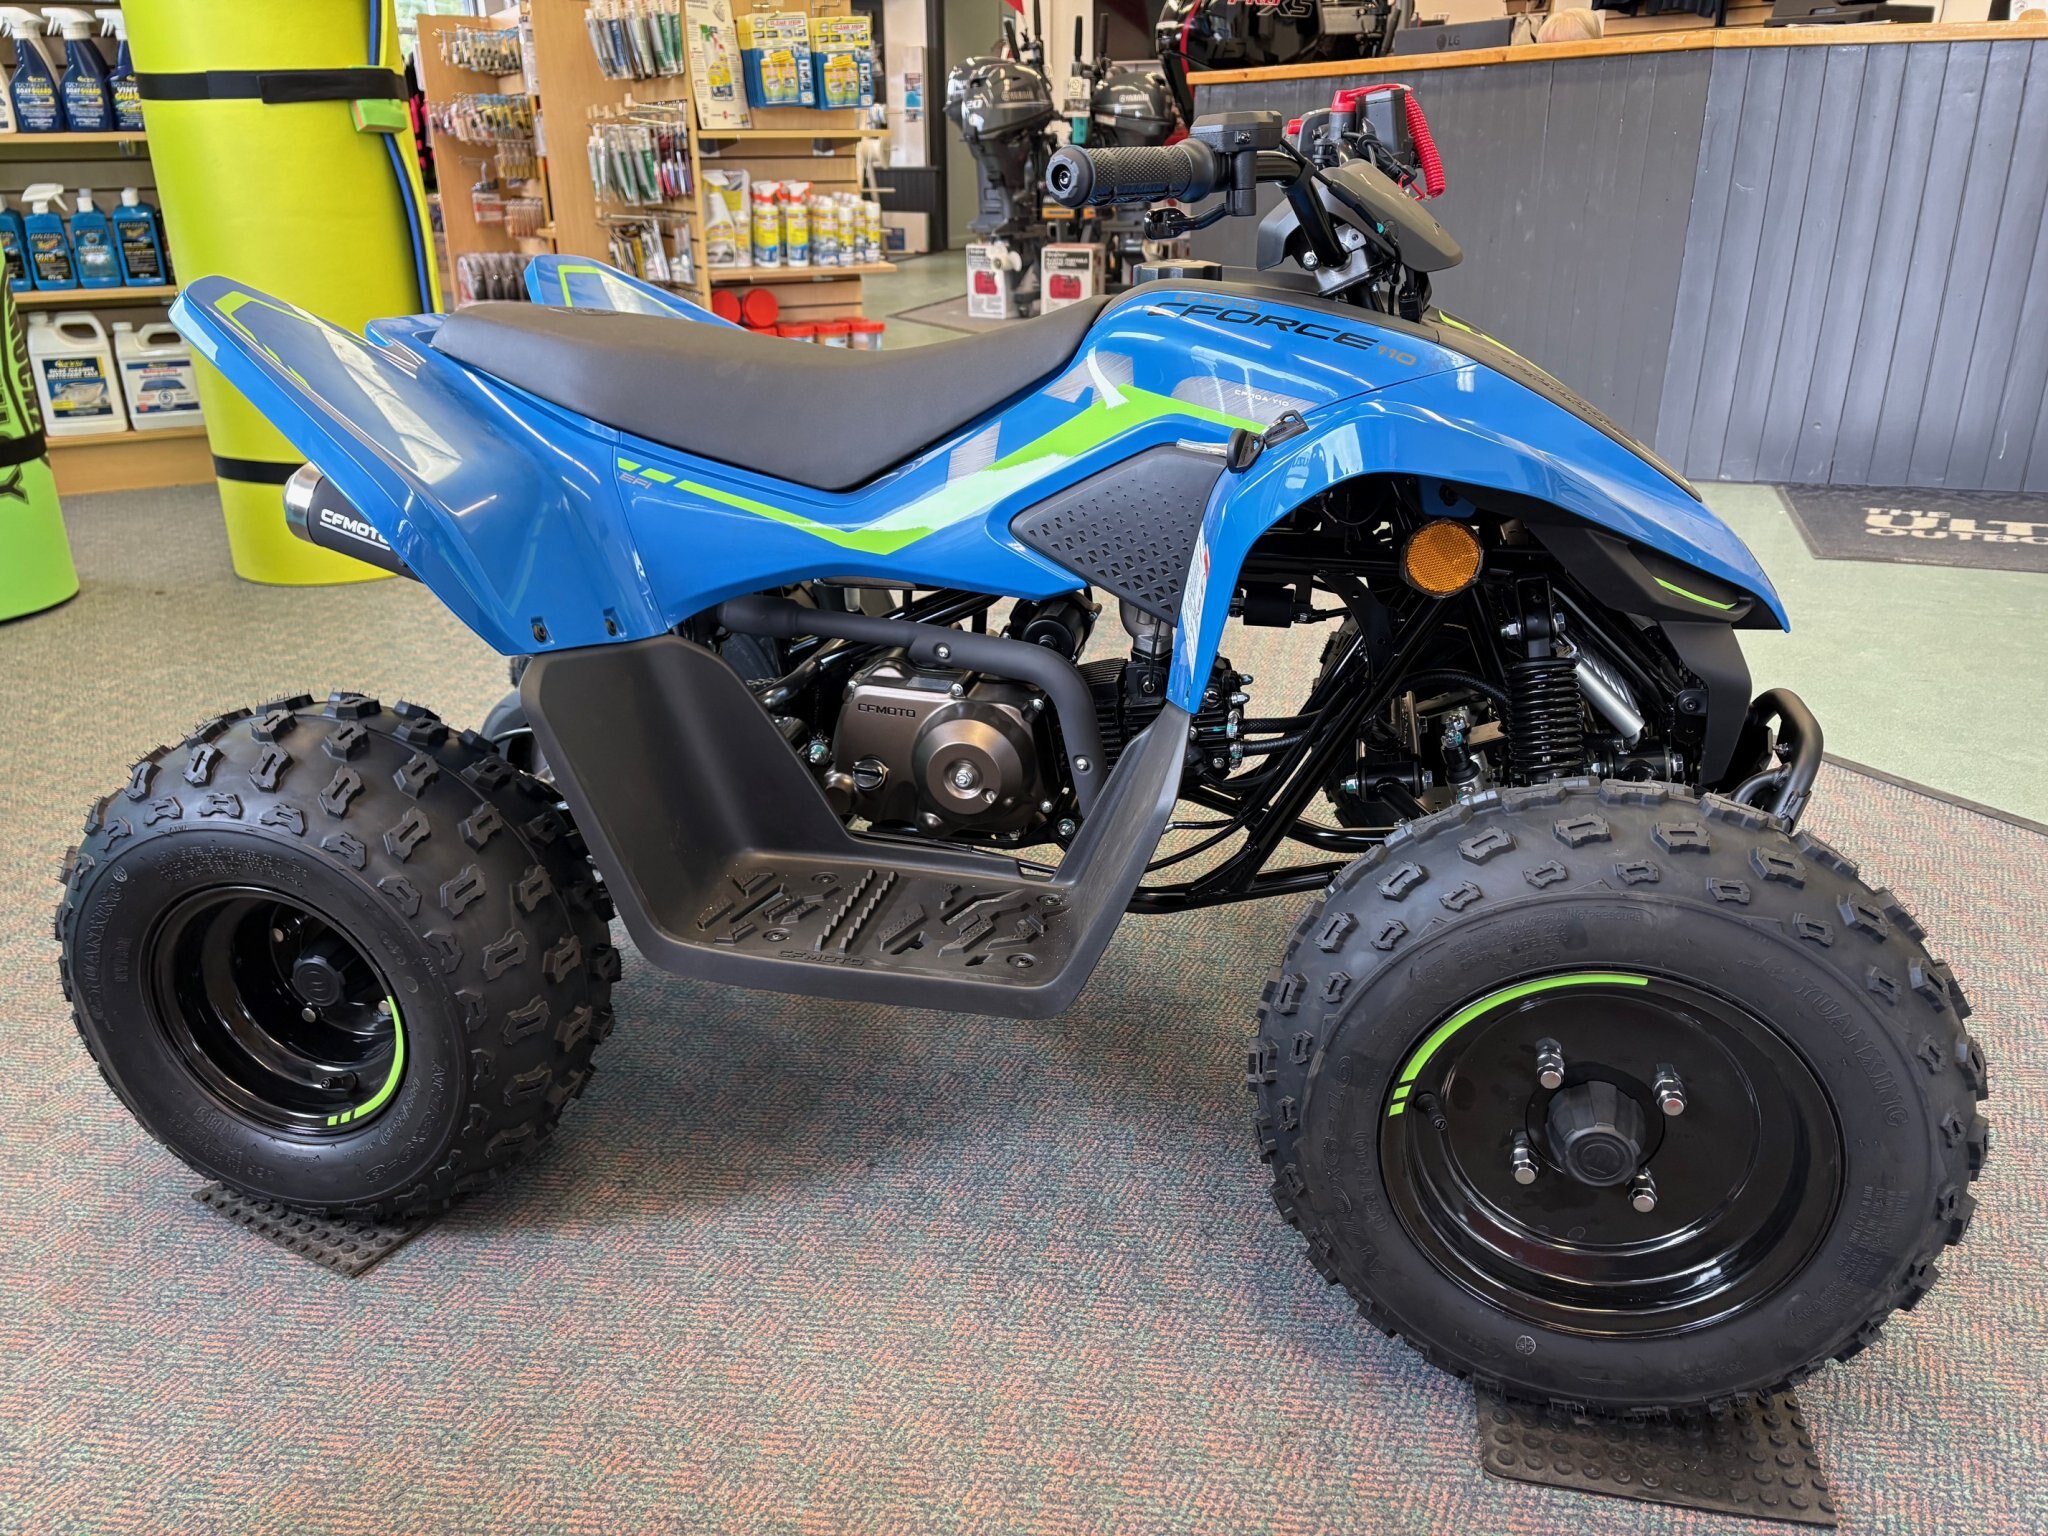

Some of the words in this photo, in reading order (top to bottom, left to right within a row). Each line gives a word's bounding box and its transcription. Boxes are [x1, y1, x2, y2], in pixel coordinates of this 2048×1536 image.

[1447, 35, 1461, 46] LG
[1174, 293, 1262, 311] CFMOTO
[1146, 301, 1380, 351] CFORCE
[1377, 345, 1419, 367] 110
[619, 472, 653, 490] EFI
[1861, 507, 1951, 518] THE
[857, 702, 916, 718] CFMOTO
[778, 950, 865, 967] CFMOTO
